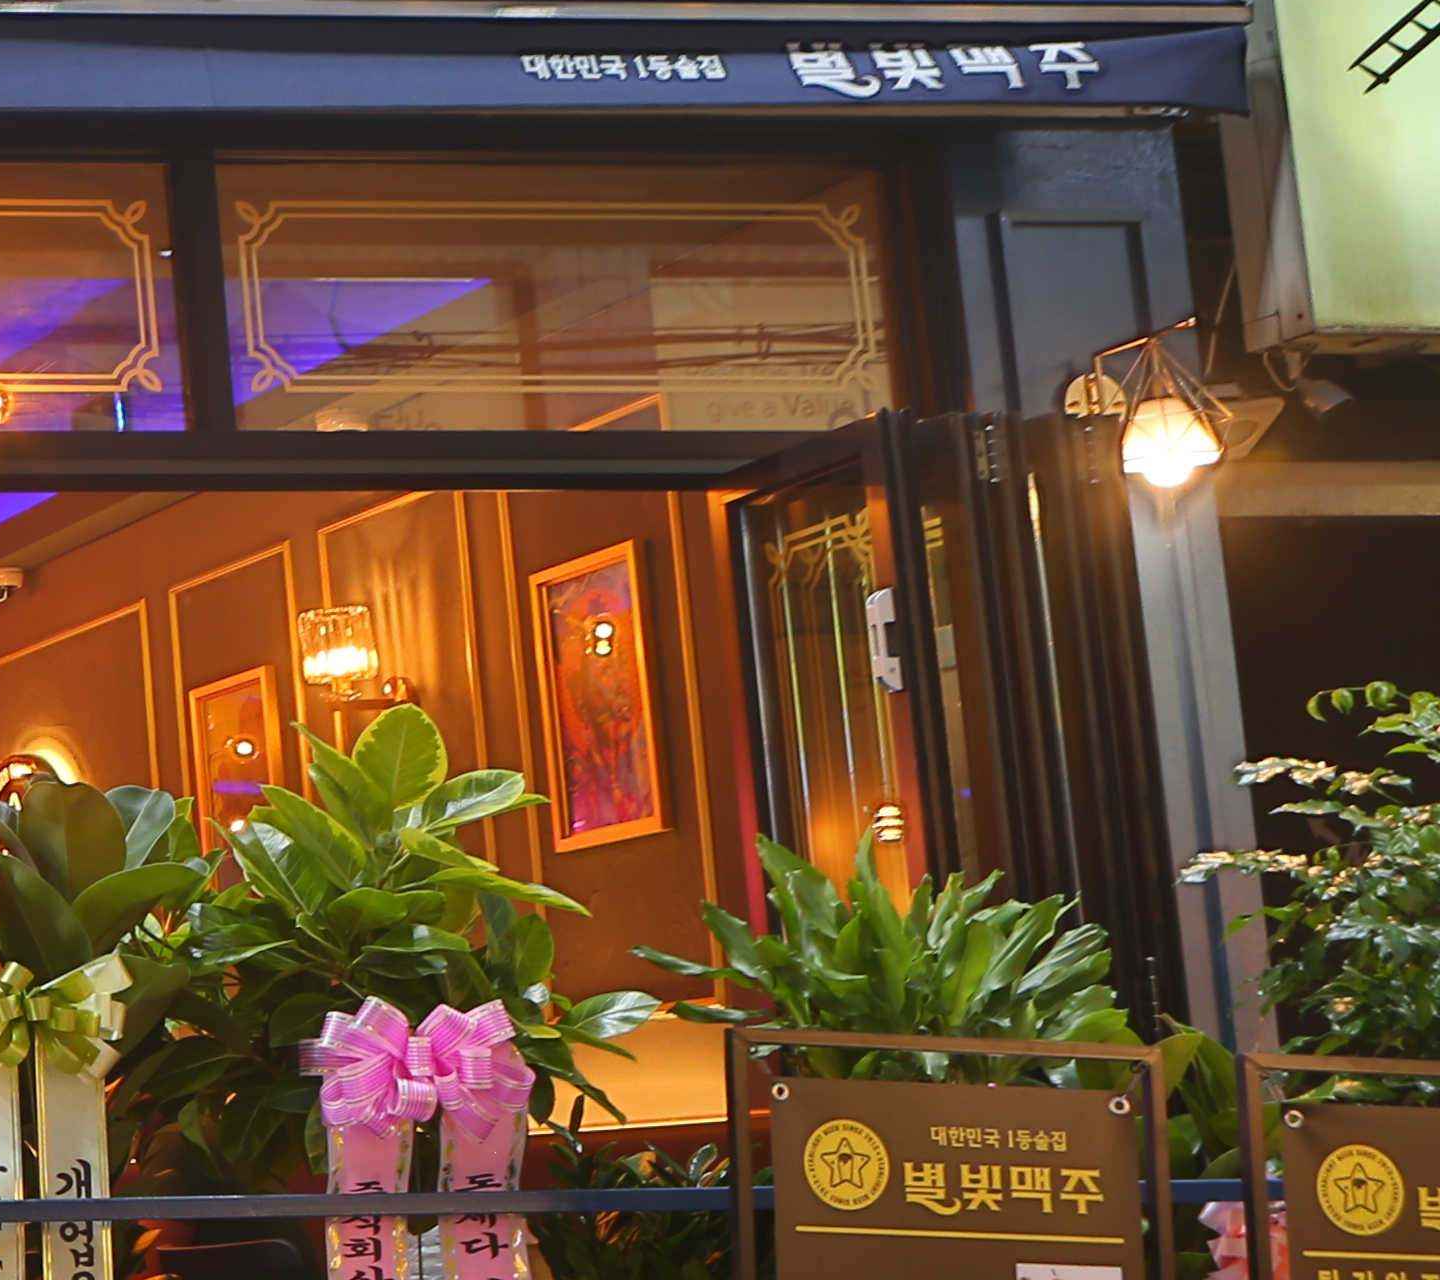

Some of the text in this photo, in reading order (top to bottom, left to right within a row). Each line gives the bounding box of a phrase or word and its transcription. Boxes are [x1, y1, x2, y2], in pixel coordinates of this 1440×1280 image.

[522, 41, 1101, 99] 대한민국 1등술집 별빛맥주
[930, 1126, 1067, 1152] 대한민국 1등술집
[902, 1160, 1105, 1217] 별빛맥주
